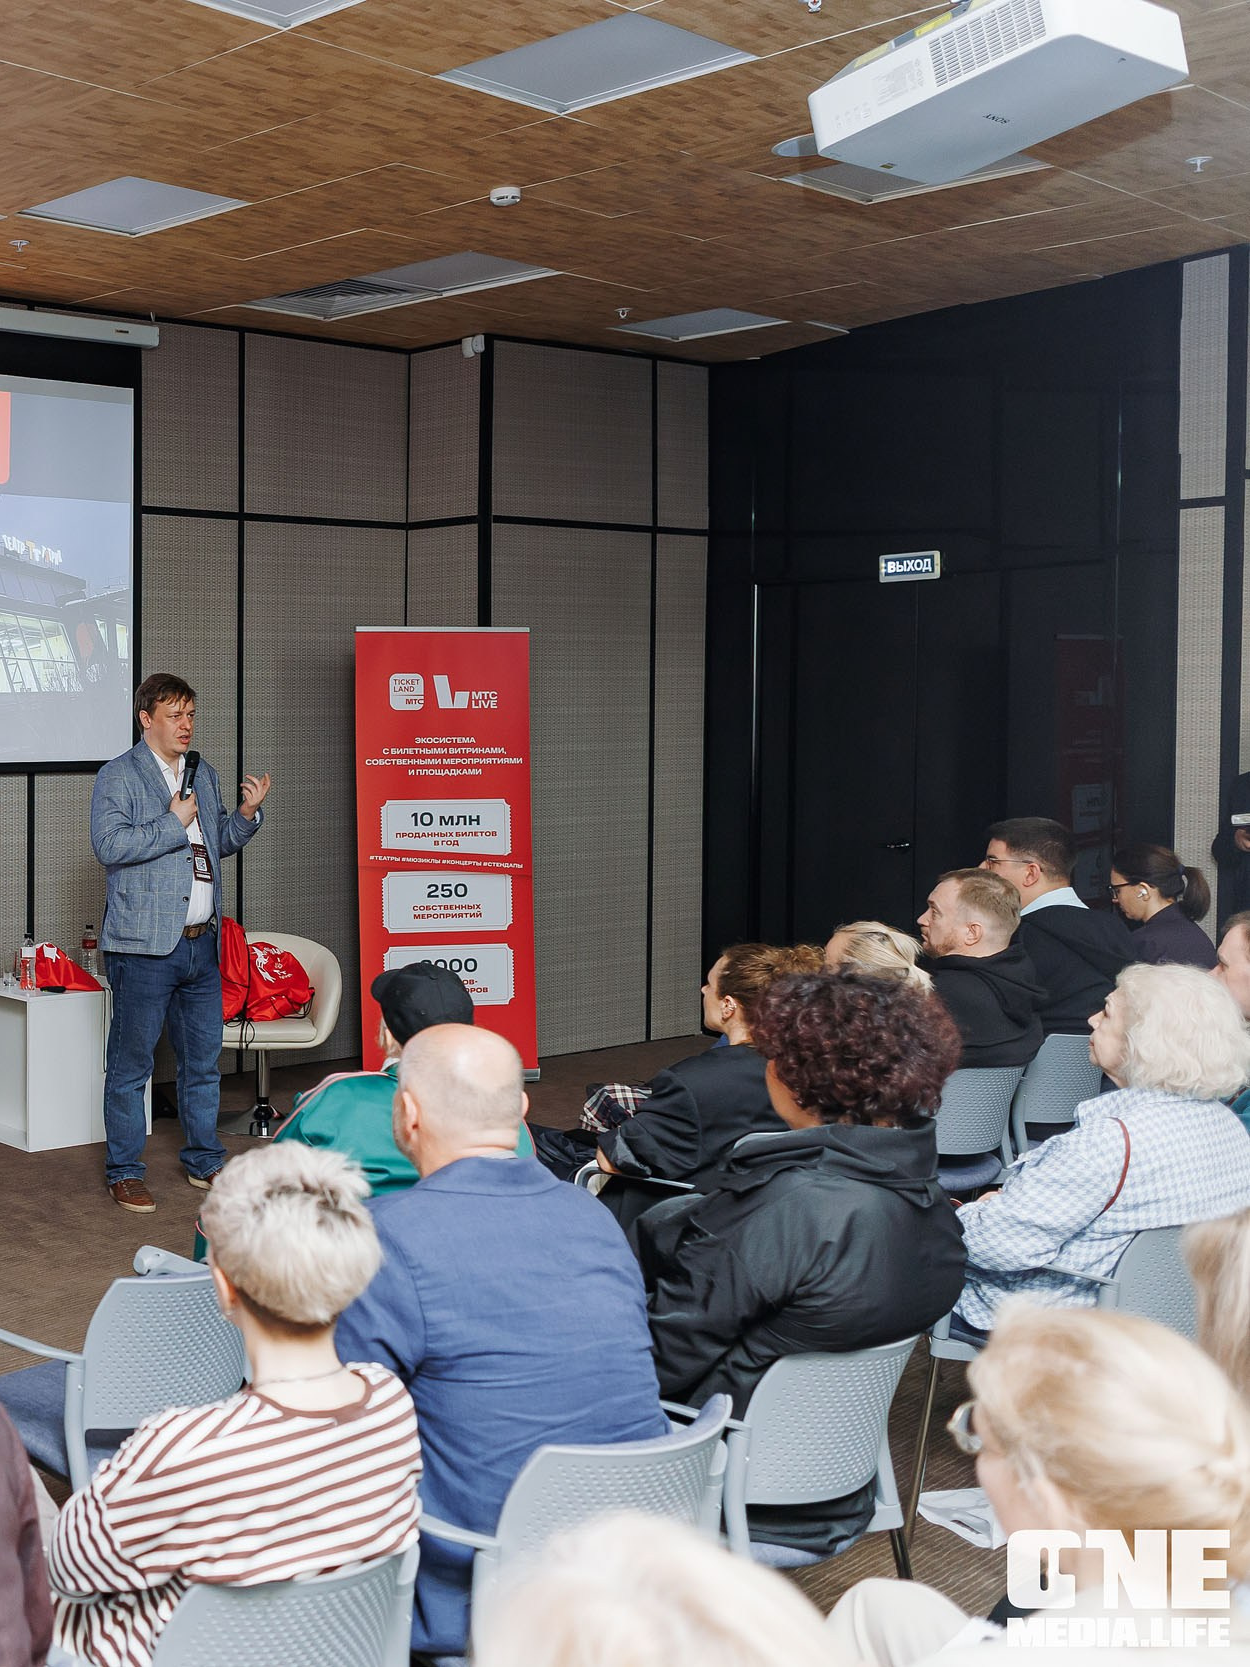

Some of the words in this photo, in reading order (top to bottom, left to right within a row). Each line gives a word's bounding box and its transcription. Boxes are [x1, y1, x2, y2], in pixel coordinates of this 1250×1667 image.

[887, 558, 932, 573] ВЫХОД
[393, 678, 420, 686] TICKET
[471, 700, 498, 709] LIVE
[449, 747, 507, 755] ВИТРИНАМИ,
[365, 758, 442, 766] СОБСТВЕННЫМИ
[443, 757, 523, 765] МЕРОПРИЯТИЯМИ
[416, 768, 482, 777] ПЛОЩАДКАМИ
[410, 812, 434, 827] 10
[395, 831, 454, 839] ПРОДАННЫХ
[455, 830, 497, 838] БИЛЕТОВ
[441, 839, 459, 847] ГОД
[442, 859, 482, 867] #КОНЦЕРТЫ
[483, 861, 523, 869] #СТЕНДАПЫ
[426, 883, 468, 898] 250
[413, 911, 482, 919] МЕРОПРИЯТИЙ
[421, 958, 478, 972] 000
